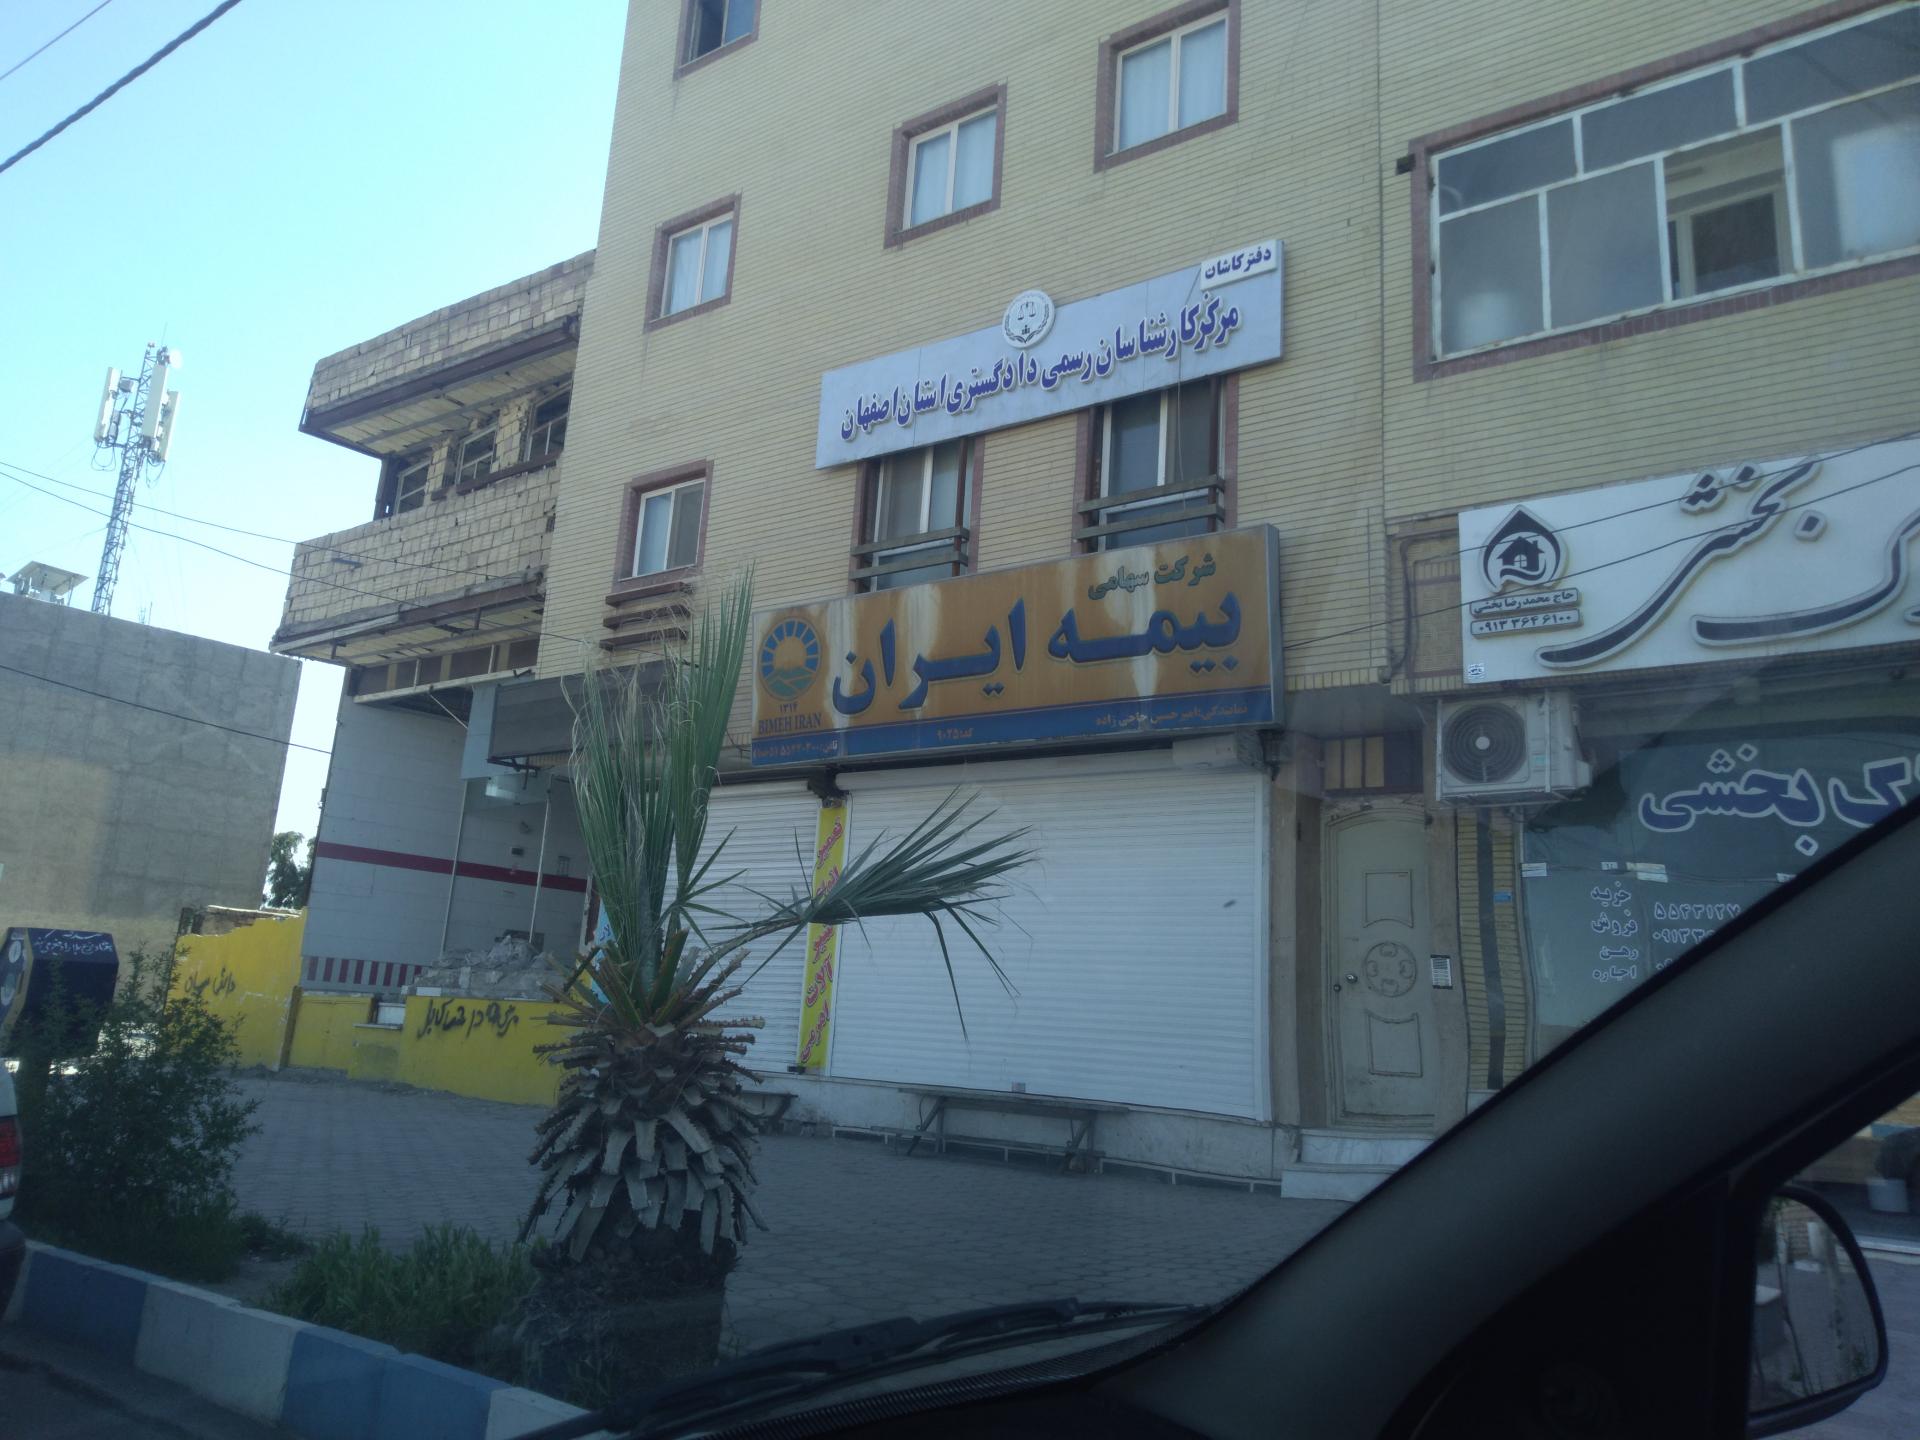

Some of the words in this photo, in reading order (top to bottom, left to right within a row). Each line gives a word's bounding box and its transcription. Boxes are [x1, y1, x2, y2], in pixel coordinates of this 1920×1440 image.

[1204, 253, 1244, 281] کاشان
[1242, 246, 1273, 275] دفتر
[1194, 288, 1240, 350] مرکز
[945, 352, 1038, 416] دادگستری
[1041, 349, 1094, 390] رسمی
[839, 387, 899, 441] اصفهان
[898, 375, 948, 426] استان
[1087, 564, 1151, 601] سهامی
[1153, 552, 1217, 588] شرکت
[1046, 591, 1243, 674] بیمه
[1479, 619, 1508, 633] ۰۹۱۳
[831, 598, 1028, 716] ایران
[758, 716, 793, 736] BIMEH
[795, 711, 823, 731] IRAN
[1638, 743, 1826, 857] بخشی
[1590, 880, 1633, 908] خرید
[1591, 908, 1639, 937] فروش
[1599, 943, 1640, 961] رهن
[1592, 964, 1638, 983] اجاره
